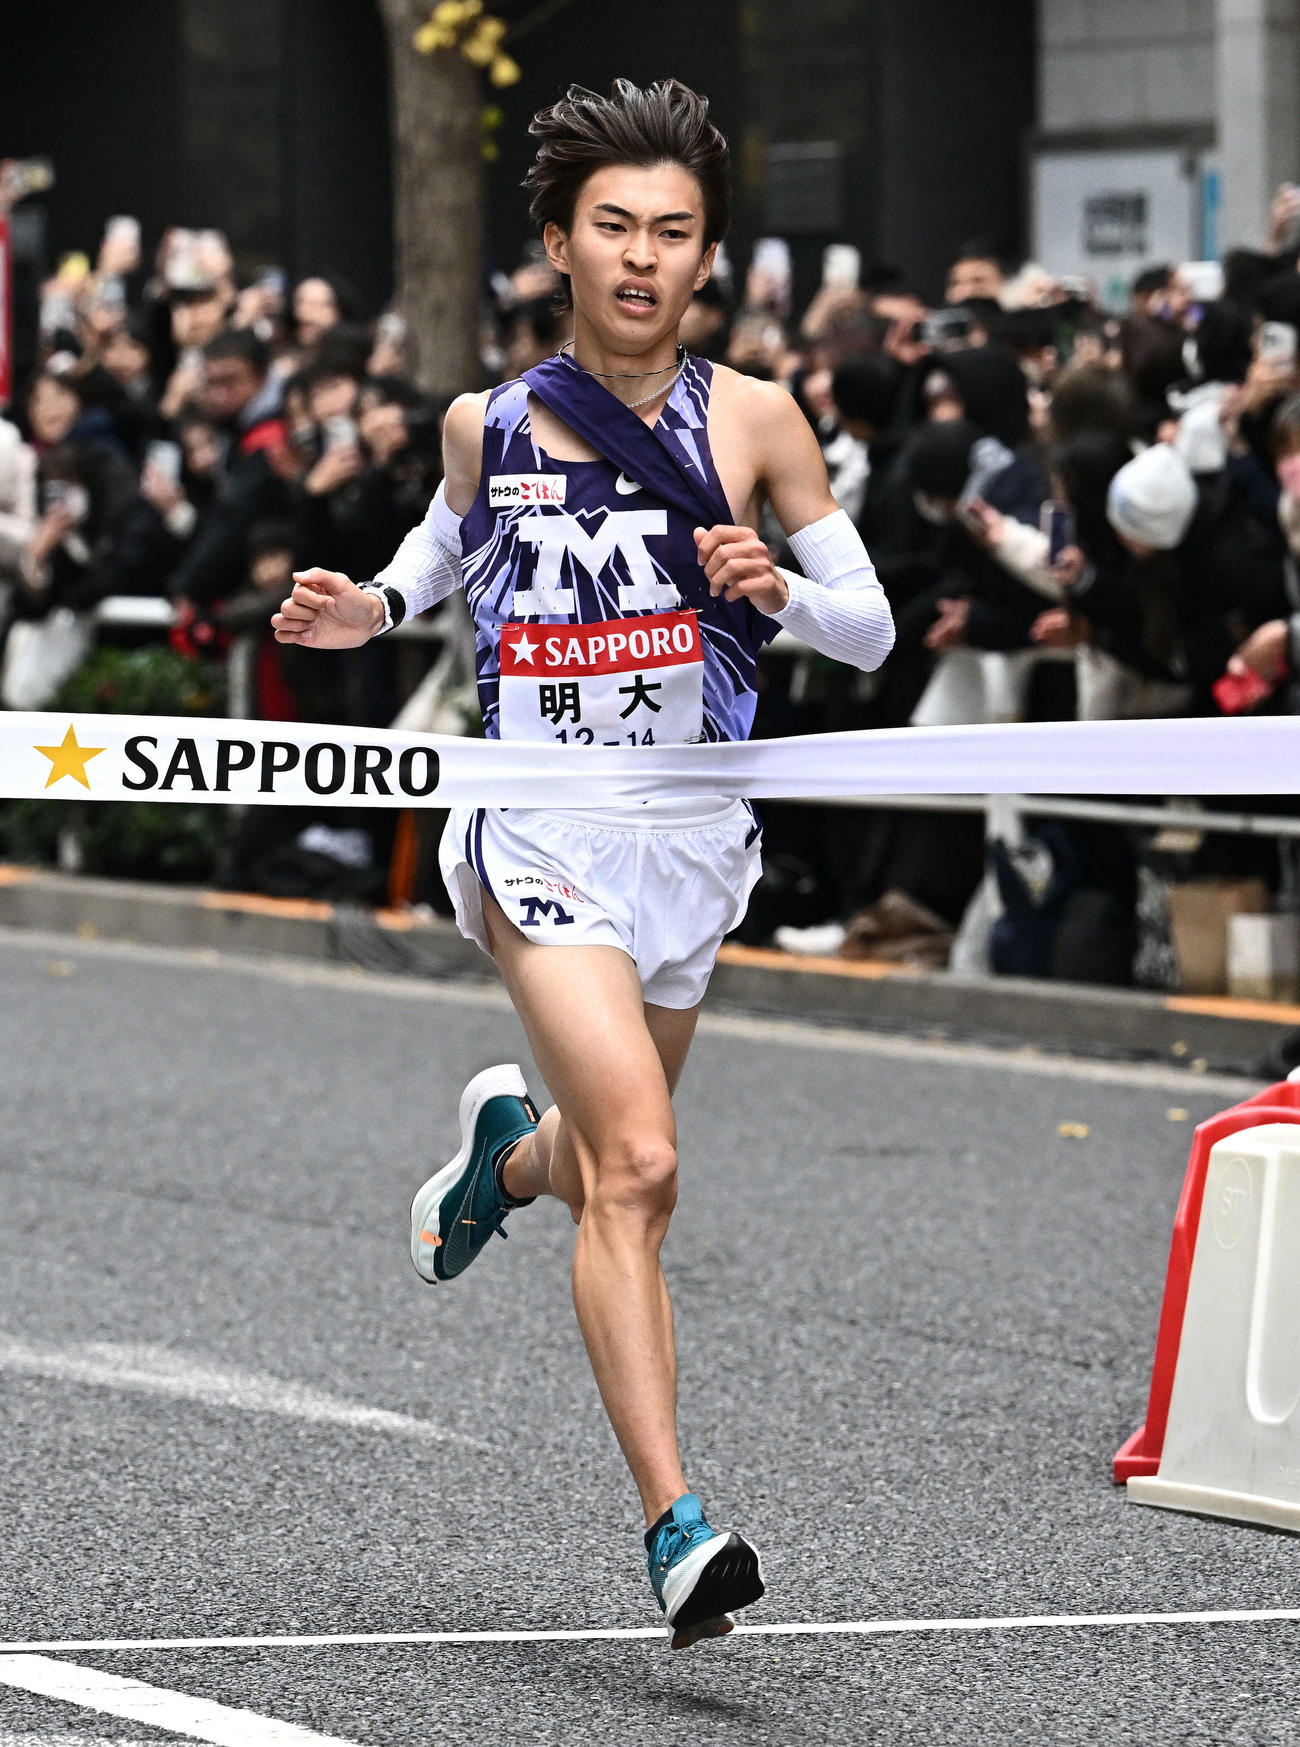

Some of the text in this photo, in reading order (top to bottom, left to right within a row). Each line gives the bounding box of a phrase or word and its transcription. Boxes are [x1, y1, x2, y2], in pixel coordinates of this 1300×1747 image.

[490, 479, 564, 501] サトウのごはん
[514, 509, 682, 616] M
[545, 623, 694, 666] SAPPORO
[122, 735, 440, 797] SAPPORO
[519, 896, 575, 926] M
